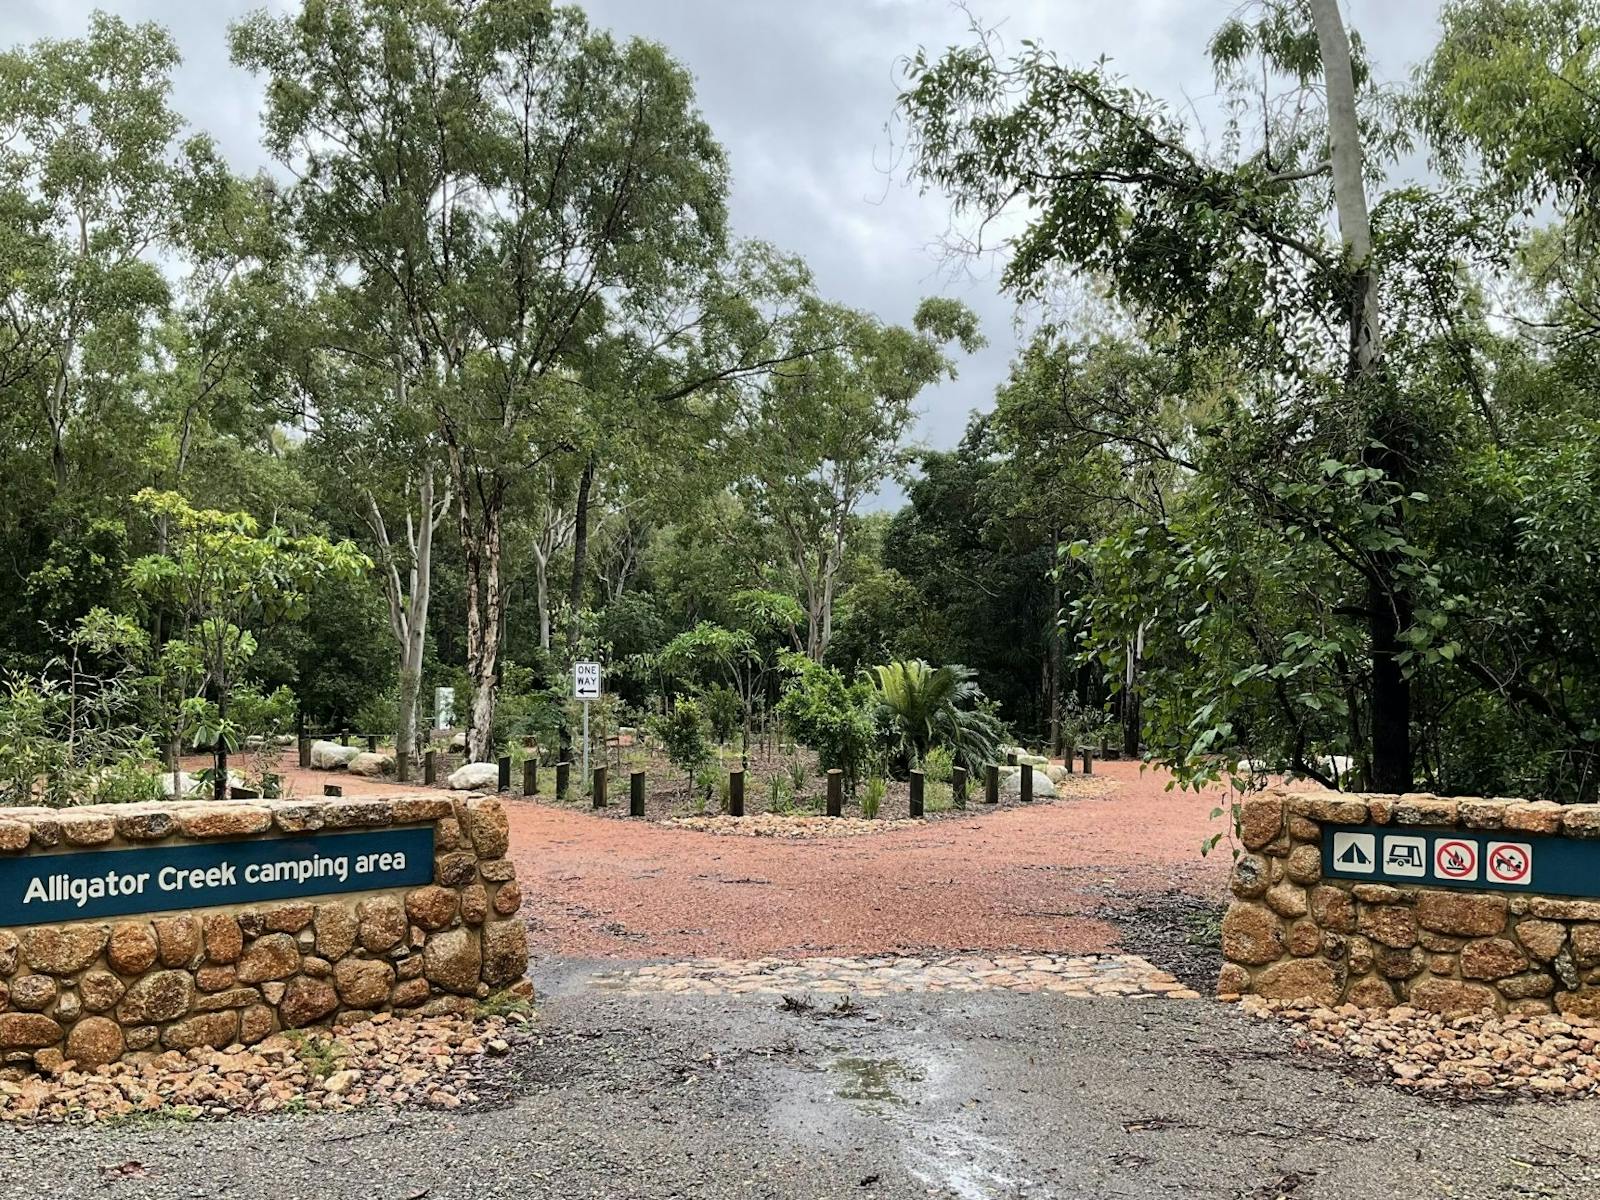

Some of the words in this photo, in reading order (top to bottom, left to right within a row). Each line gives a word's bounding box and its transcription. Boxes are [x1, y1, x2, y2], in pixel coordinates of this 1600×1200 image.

[578, 665, 597, 675] ONE
[578, 677, 597, 685] WAY
[23, 868, 150, 907] Alligator
[158, 860, 237, 891] Creek
[244, 853, 349, 884] camping
[354, 853, 406, 874] area
